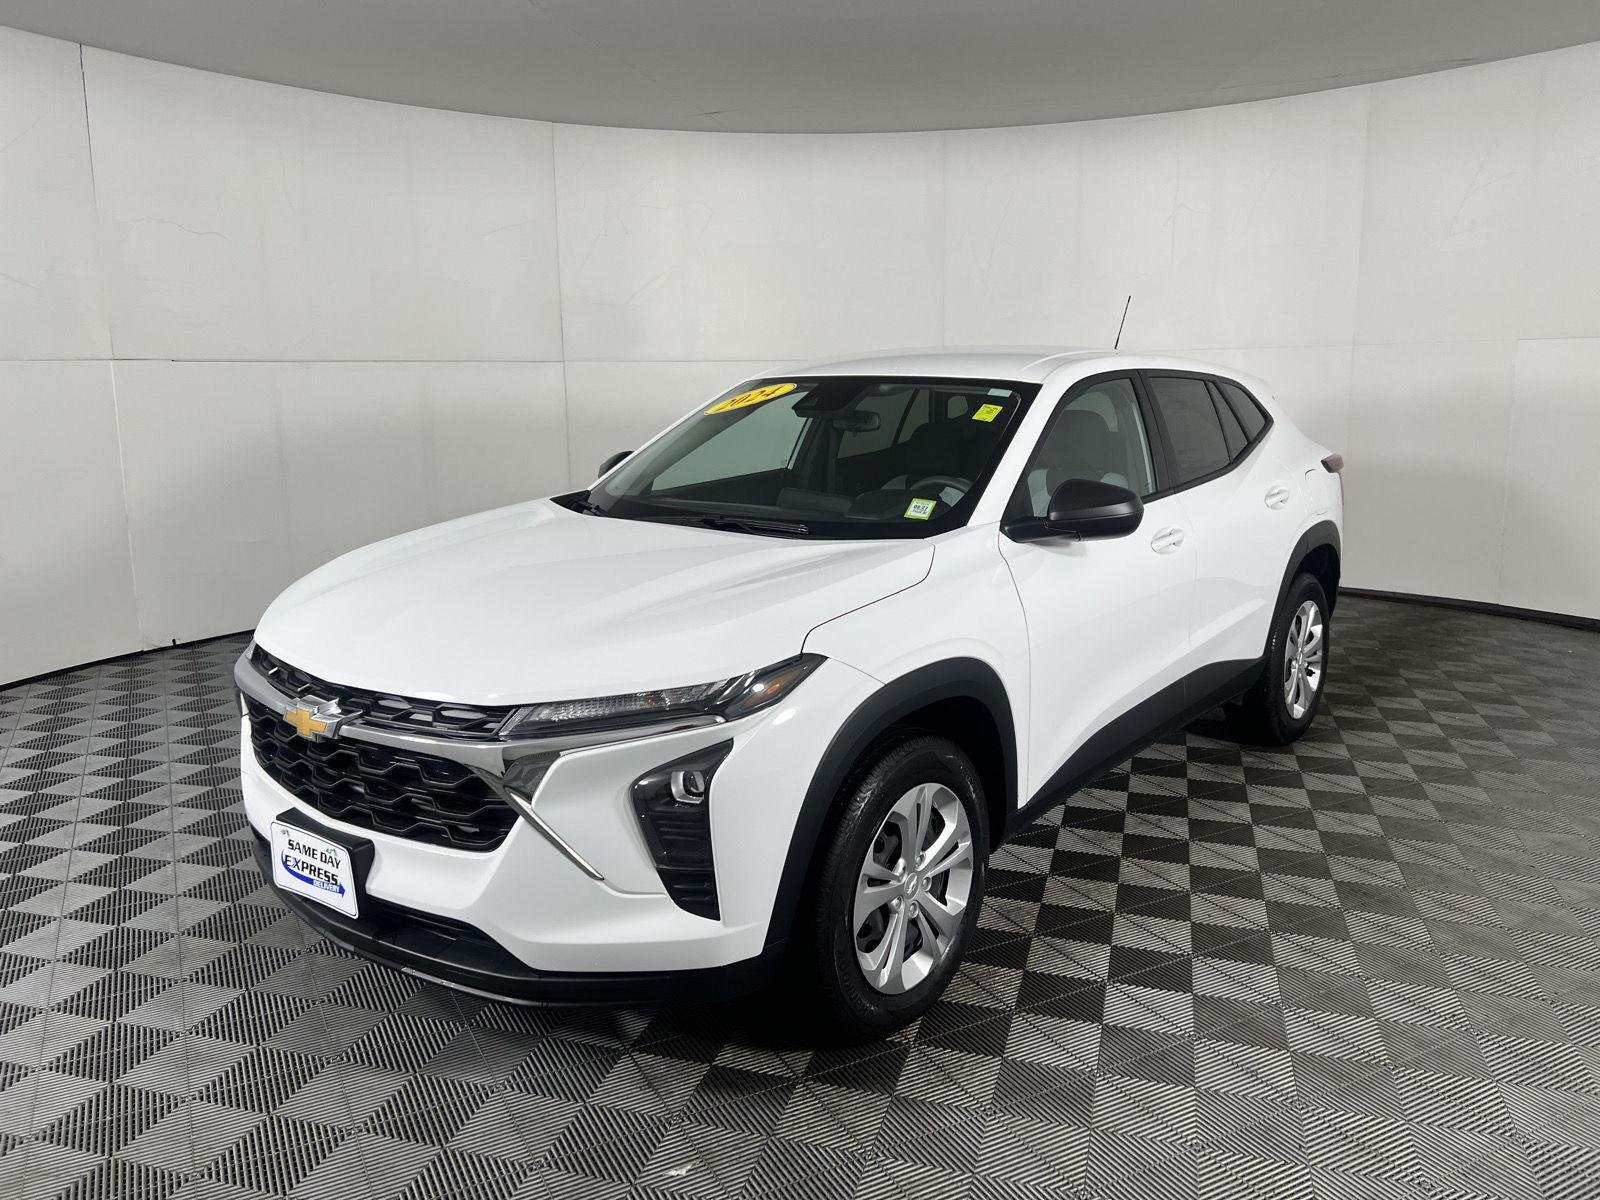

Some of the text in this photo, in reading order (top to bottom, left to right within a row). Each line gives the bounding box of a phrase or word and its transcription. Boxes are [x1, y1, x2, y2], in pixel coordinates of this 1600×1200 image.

[711, 383, 786, 411] 2024
[288, 839, 341, 869] SAME DAY
[285, 854, 339, 885] EXPRESS
[313, 879, 340, 893] DELIVERY
